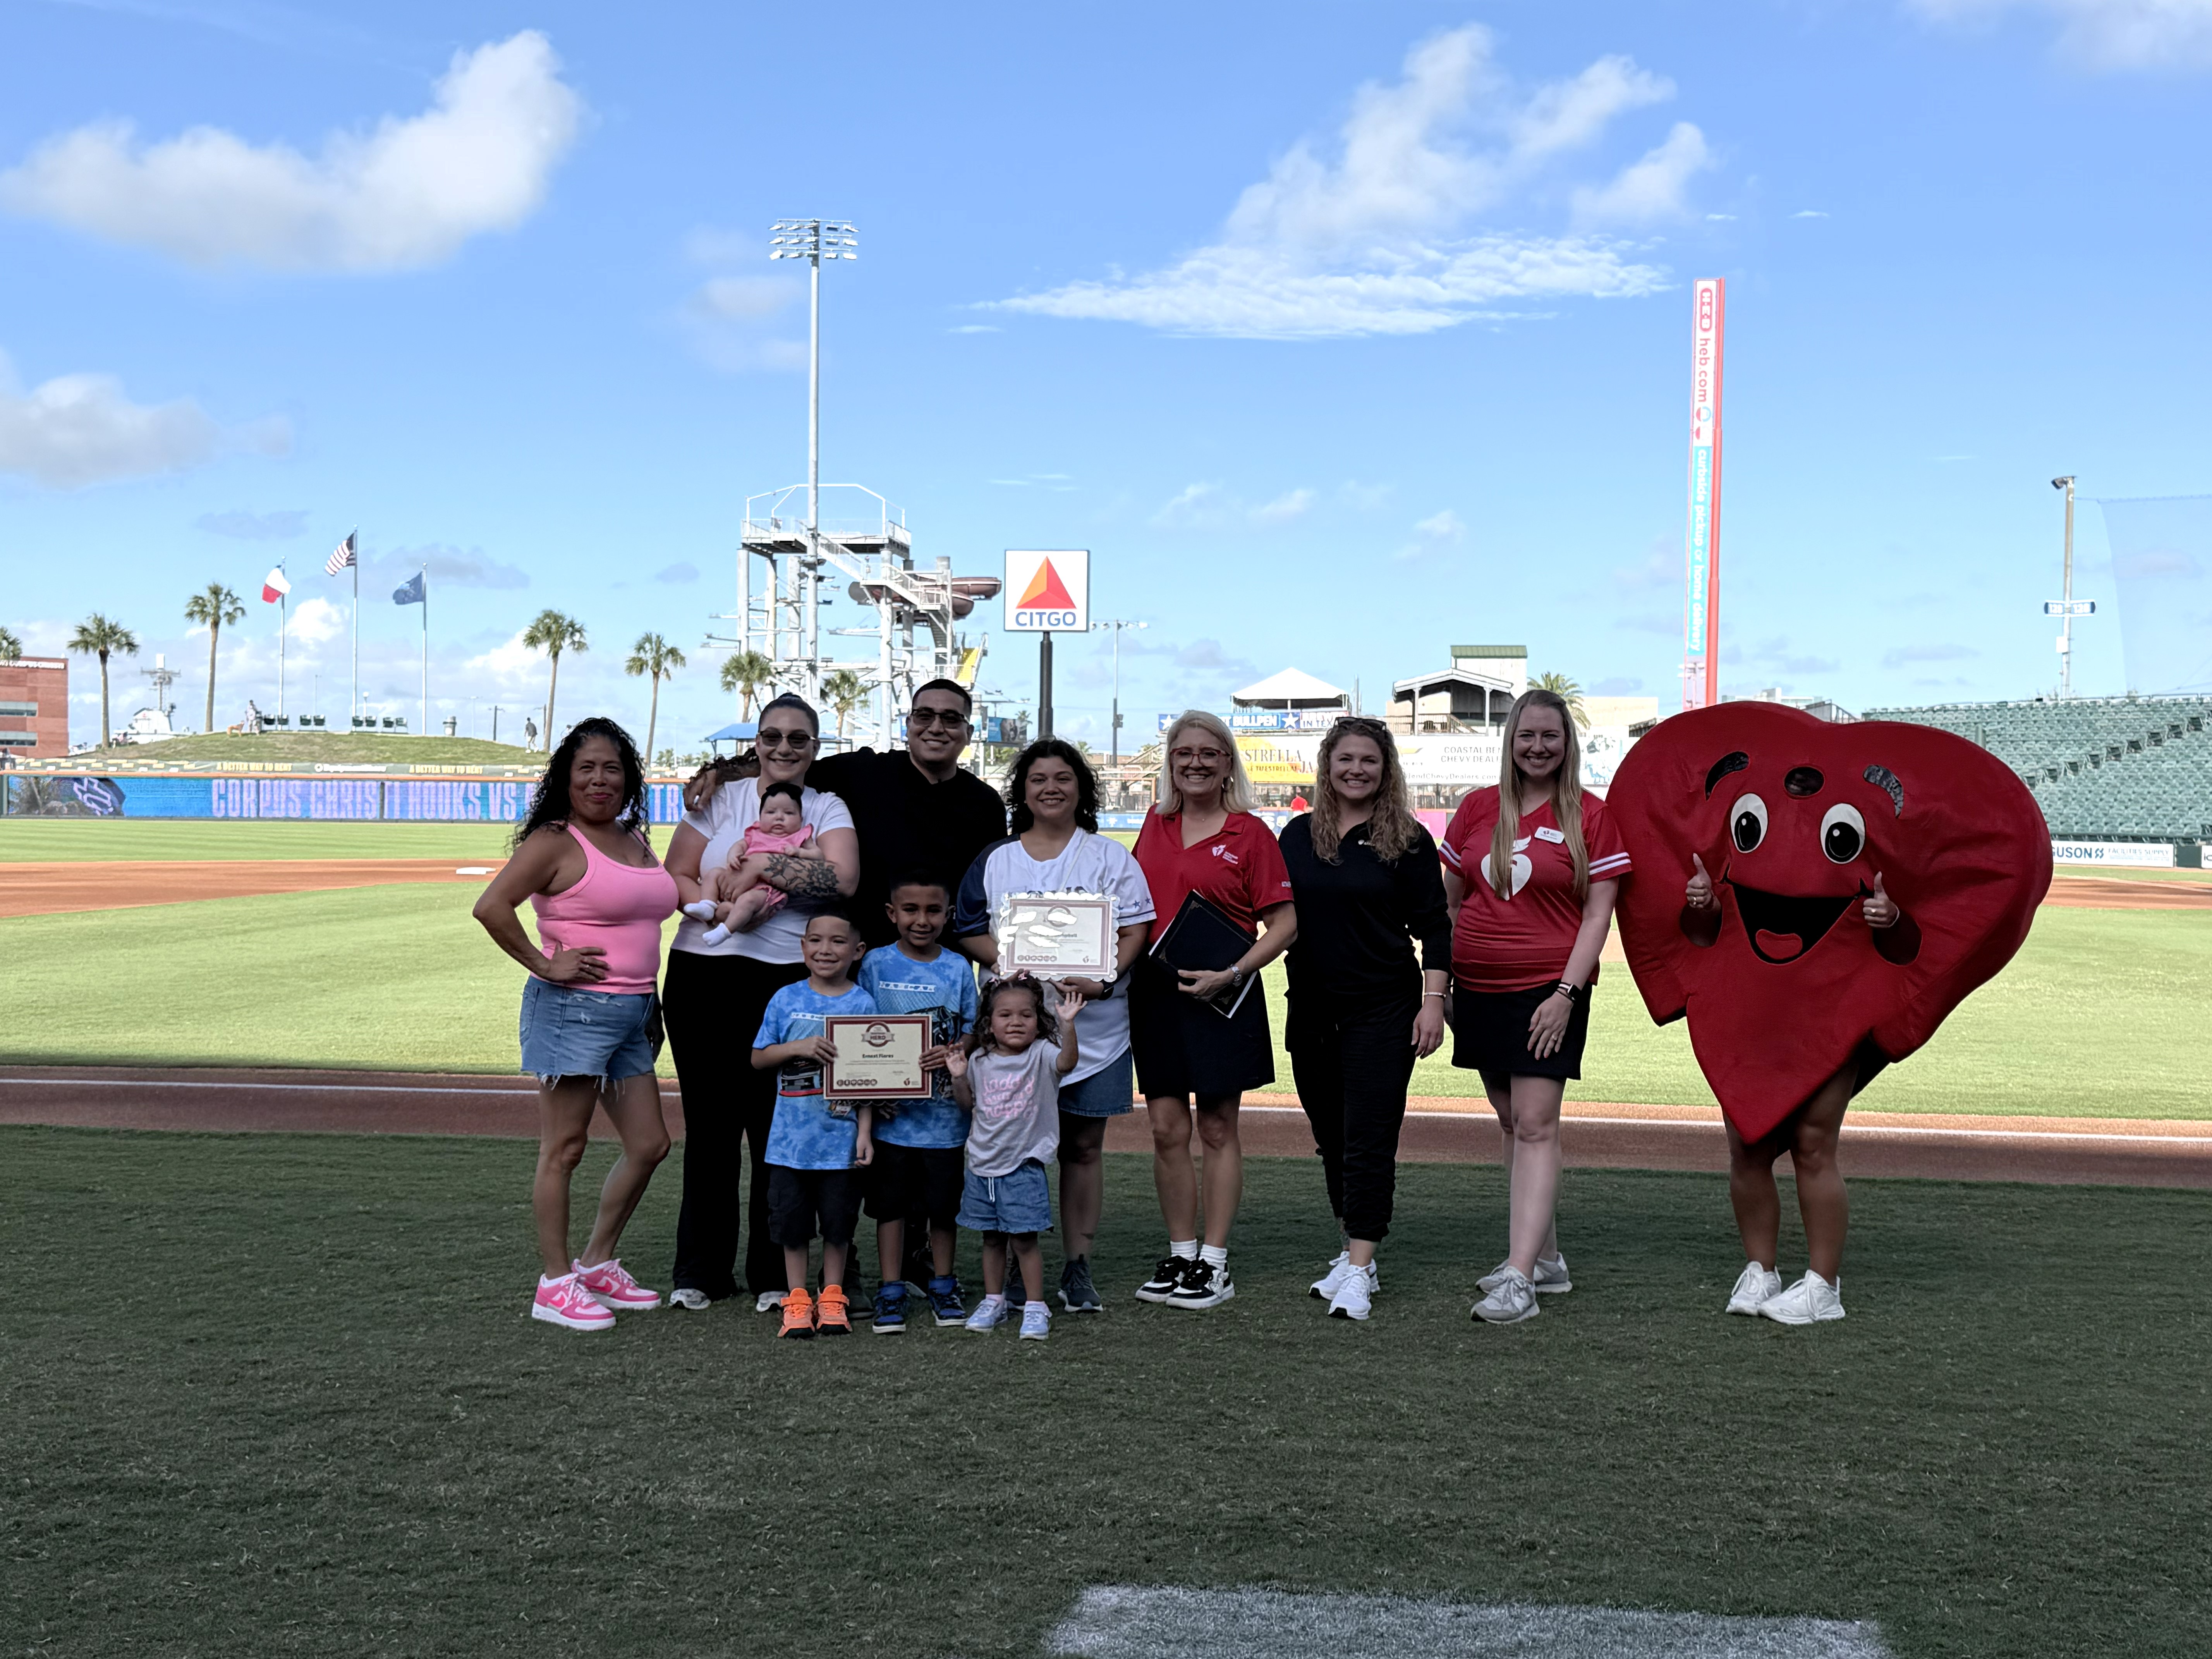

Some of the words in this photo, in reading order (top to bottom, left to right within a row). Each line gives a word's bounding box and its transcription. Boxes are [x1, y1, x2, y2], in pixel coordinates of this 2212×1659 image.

[1698, 338, 1711, 403] heb.com
[1697, 450, 1707, 502] curbside
[1693, 505, 1705, 547] pickup
[1695, 550, 1702, 562] or
[1693, 565, 1704, 599] home
[1015, 611, 1077, 627] CITGO
[2049, 603, 2063, 614] 128
[2073, 603, 2090, 614] 128
[1690, 603, 1703, 651] delivery
[1233, 715, 1277, 726] BULLPEN
[1242, 749, 1302, 762] STRELLA
[212, 779, 301, 818] CORPUS
[310, 780, 400, 819] CHRISTI
[408, 781, 481, 820] HOOKS
[488, 782, 517, 820] VS
